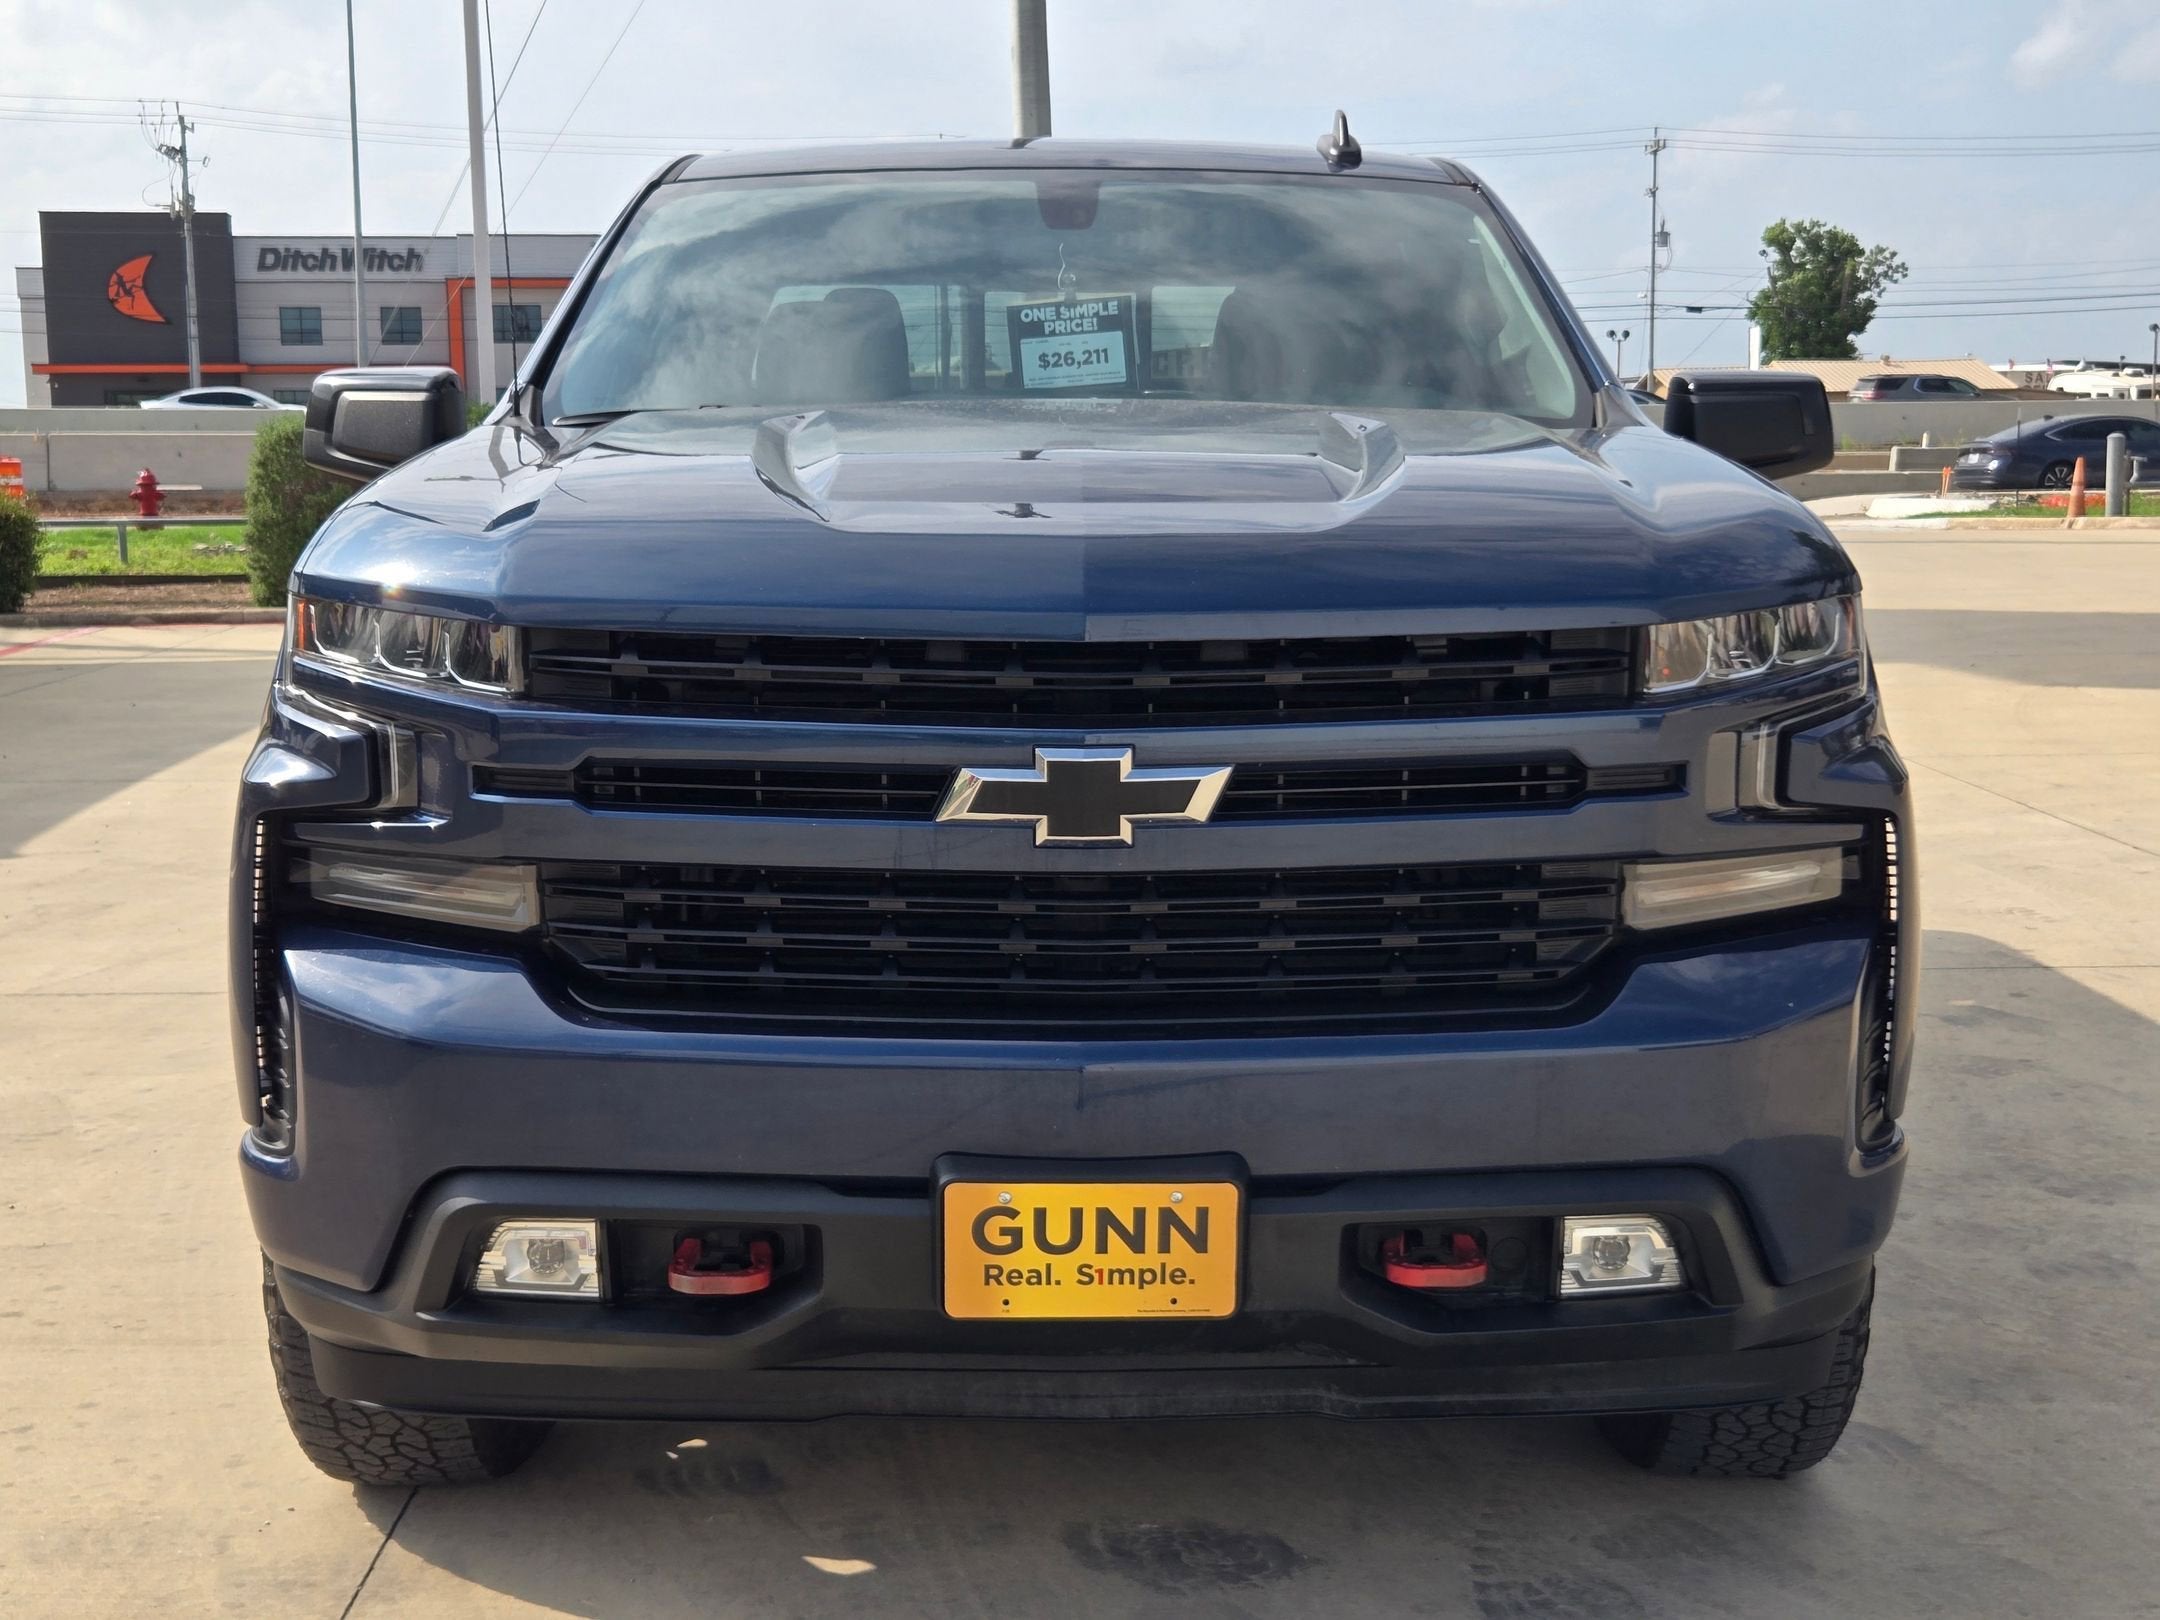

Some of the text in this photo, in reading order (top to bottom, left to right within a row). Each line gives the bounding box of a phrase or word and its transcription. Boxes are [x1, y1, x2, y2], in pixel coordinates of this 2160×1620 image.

[257, 247, 424, 273] Ditch Witch
[1020, 301, 1119, 323] ONE SIMPLE
[1044, 317, 1098, 334] PRICE!
[1038, 348, 1109, 371] $26,211
[971, 1205, 1209, 1255] GUNN
[983, 1262, 1061, 1286] Real.
